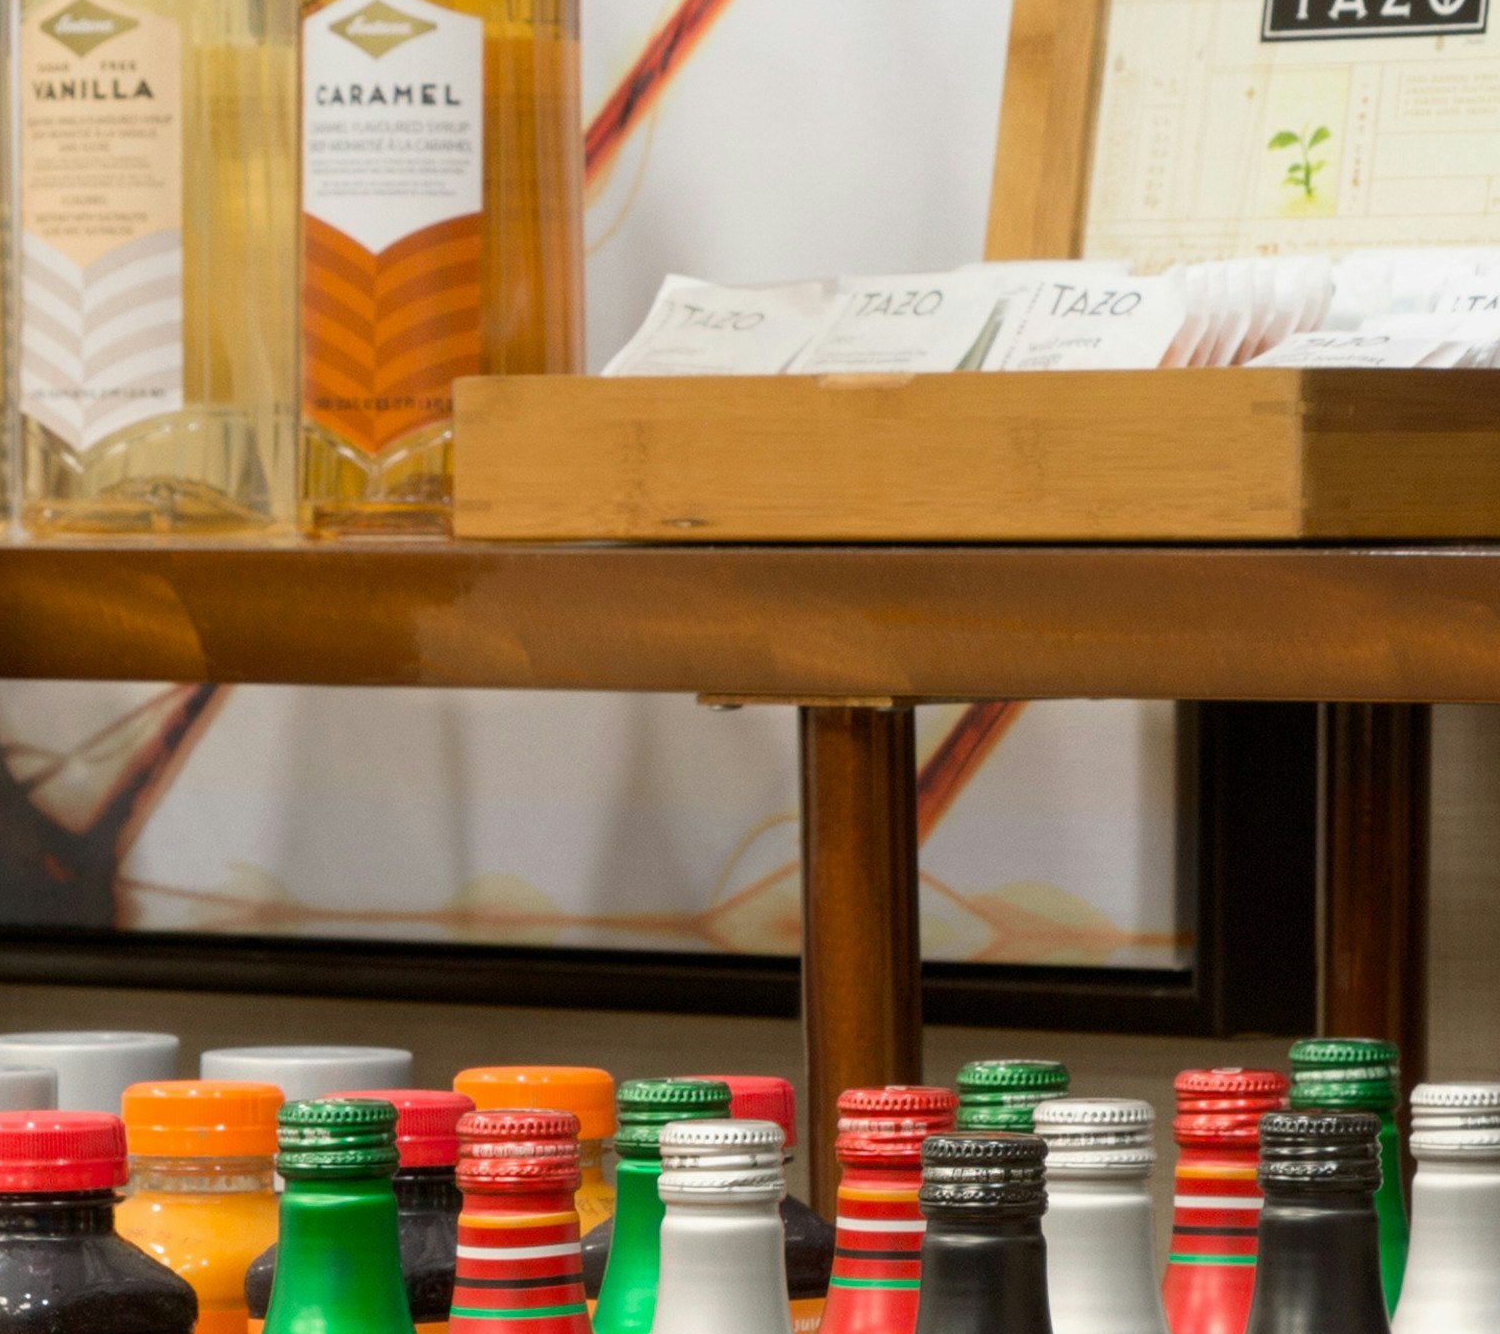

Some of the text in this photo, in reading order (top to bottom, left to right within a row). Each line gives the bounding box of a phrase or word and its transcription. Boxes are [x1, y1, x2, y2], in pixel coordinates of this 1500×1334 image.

[32, 79, 154, 100] VANILLA
[316, 83, 461, 106] CARAMEL
[861, 288, 943, 317] TAZO
[1051, 284, 1141, 317] TAZO
[680, 304, 766, 331] TAZO
